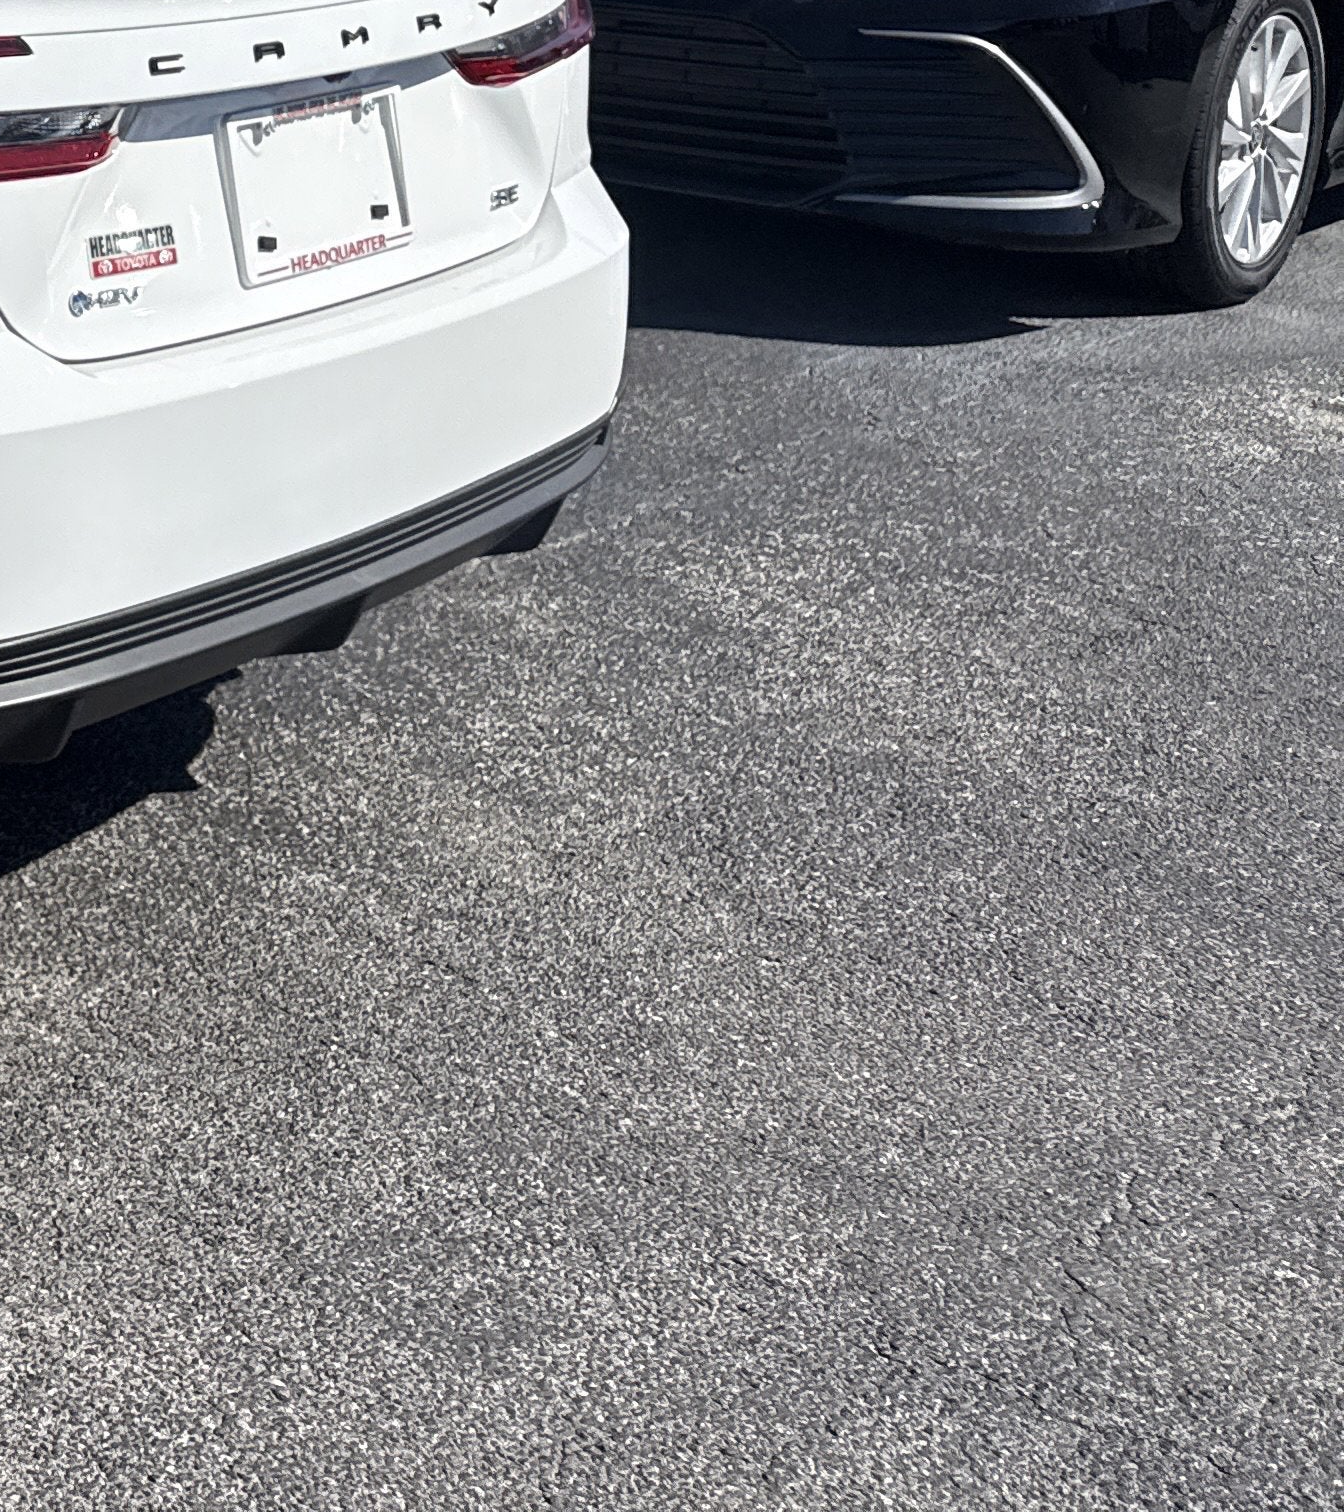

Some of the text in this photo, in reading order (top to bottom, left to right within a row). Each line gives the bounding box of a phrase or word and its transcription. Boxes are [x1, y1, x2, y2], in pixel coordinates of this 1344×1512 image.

[489, 184, 519, 212] SE
[113, 253, 157, 272] TOYOTA
[289, 234, 387, 273] HEADQUARTER
